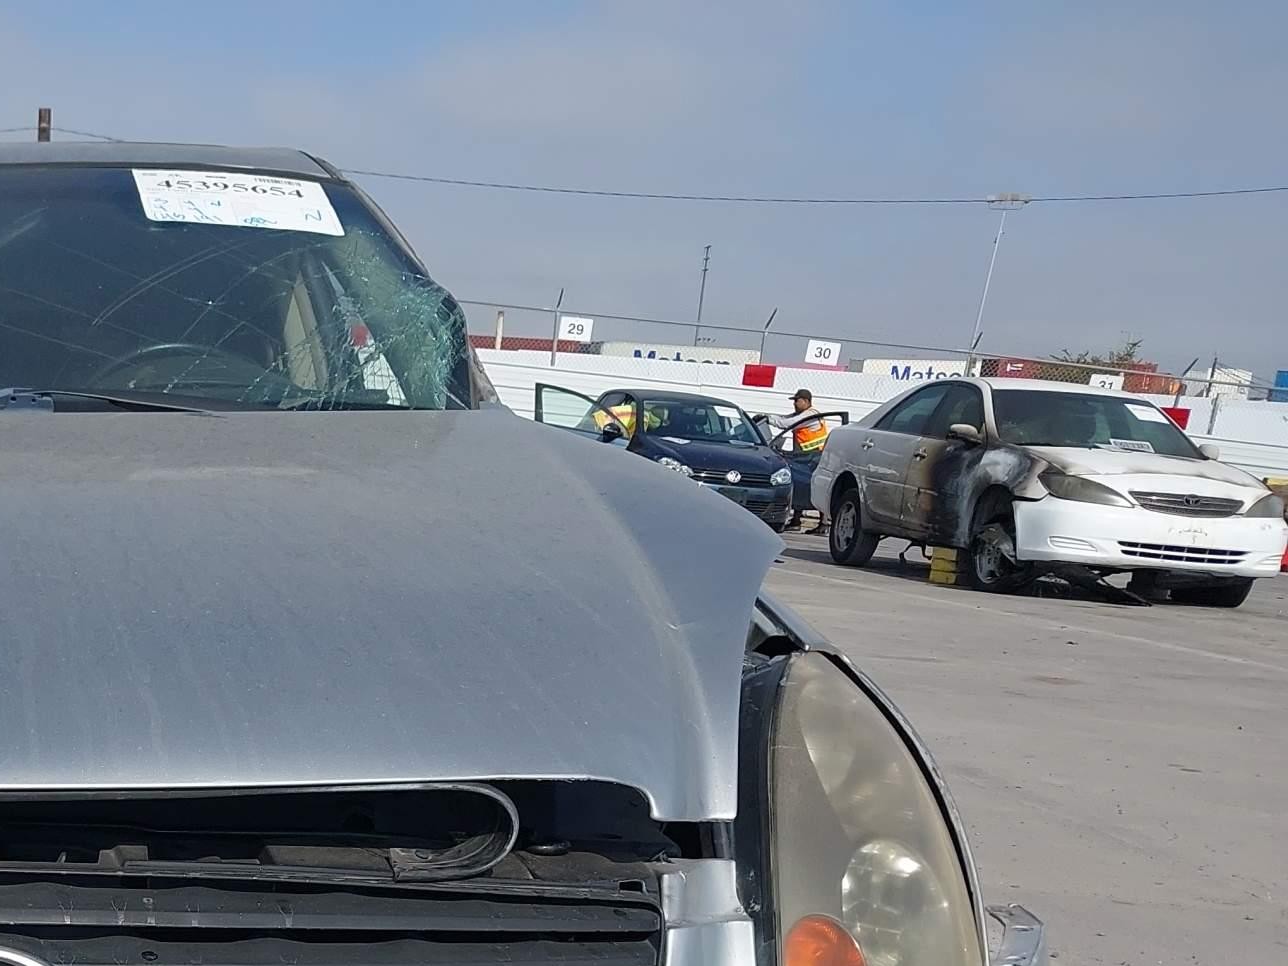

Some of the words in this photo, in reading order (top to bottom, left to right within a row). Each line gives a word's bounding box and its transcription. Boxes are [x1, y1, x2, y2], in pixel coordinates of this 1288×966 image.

[157, 180, 304, 198] 45395654
[567, 323, 584, 335] 29
[814, 347, 831, 359] 30
[891, 365, 976, 381] Mats
